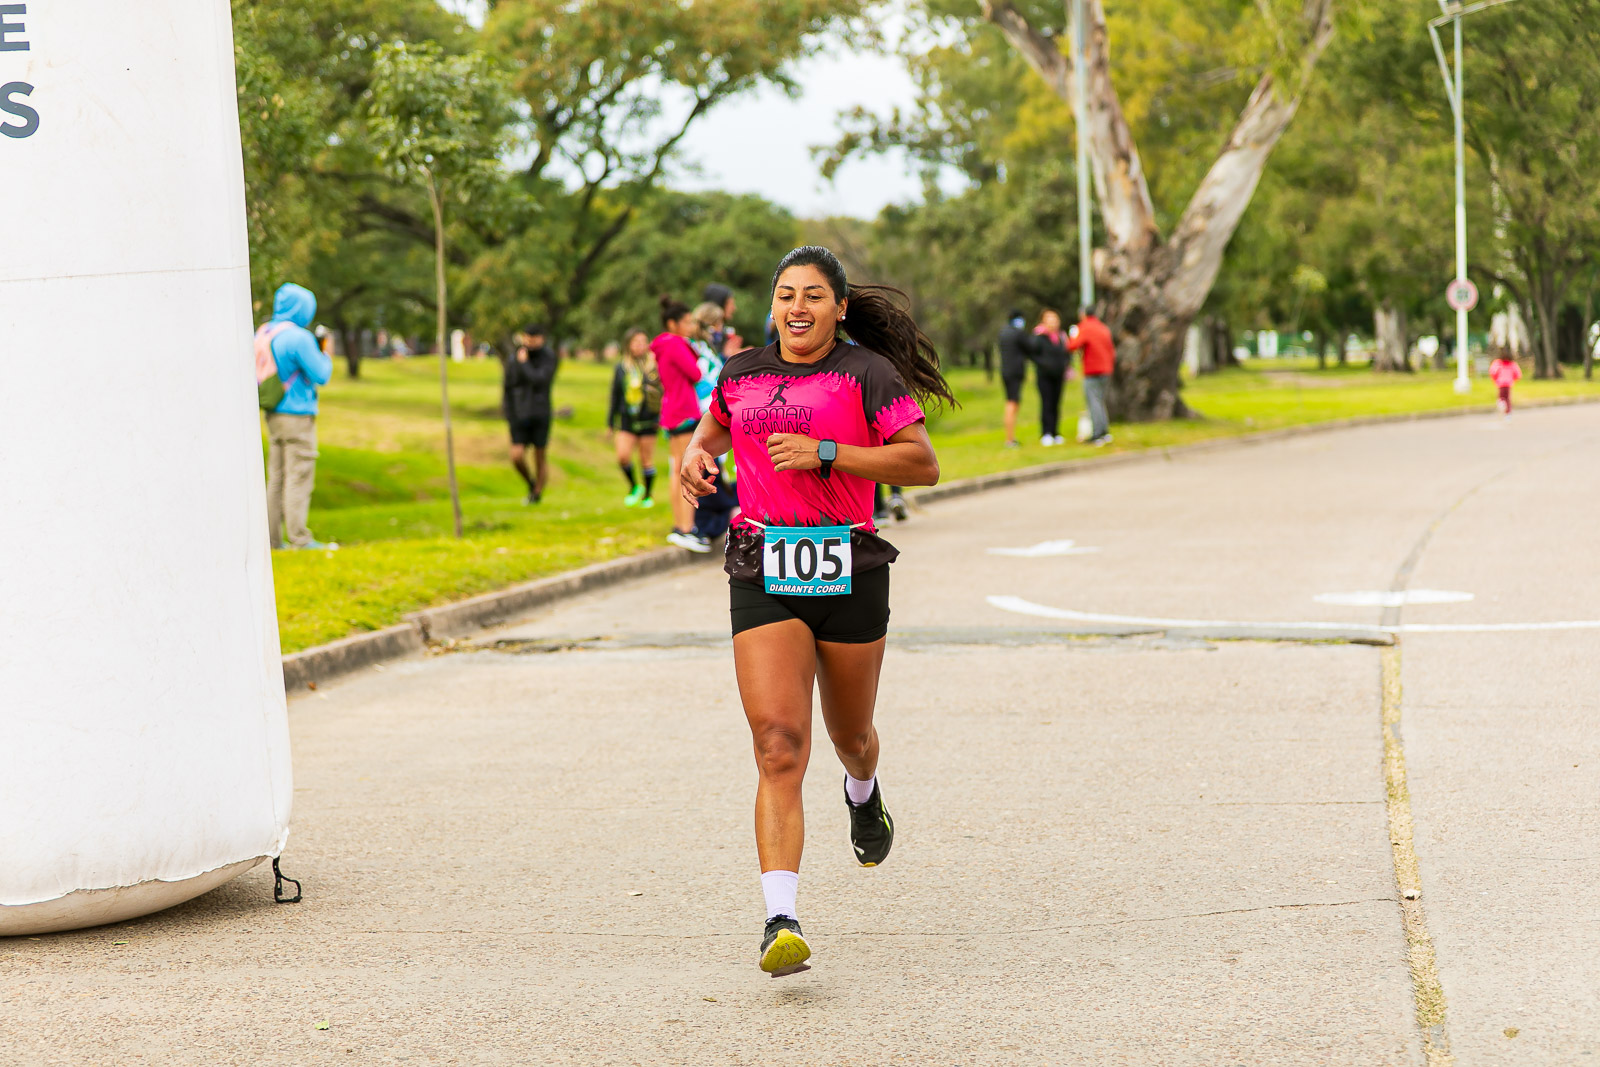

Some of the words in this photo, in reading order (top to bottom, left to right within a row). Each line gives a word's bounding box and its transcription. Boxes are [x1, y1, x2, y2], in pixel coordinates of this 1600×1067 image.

[0, 81, 40, 138] S
[741, 407, 813, 422] WOMAN
[742, 420, 811, 435] RUNNING
[770, 538, 843, 582] 105
[769, 584, 815, 594] DIAMANTE
[815, 584, 847, 593] CORRE
